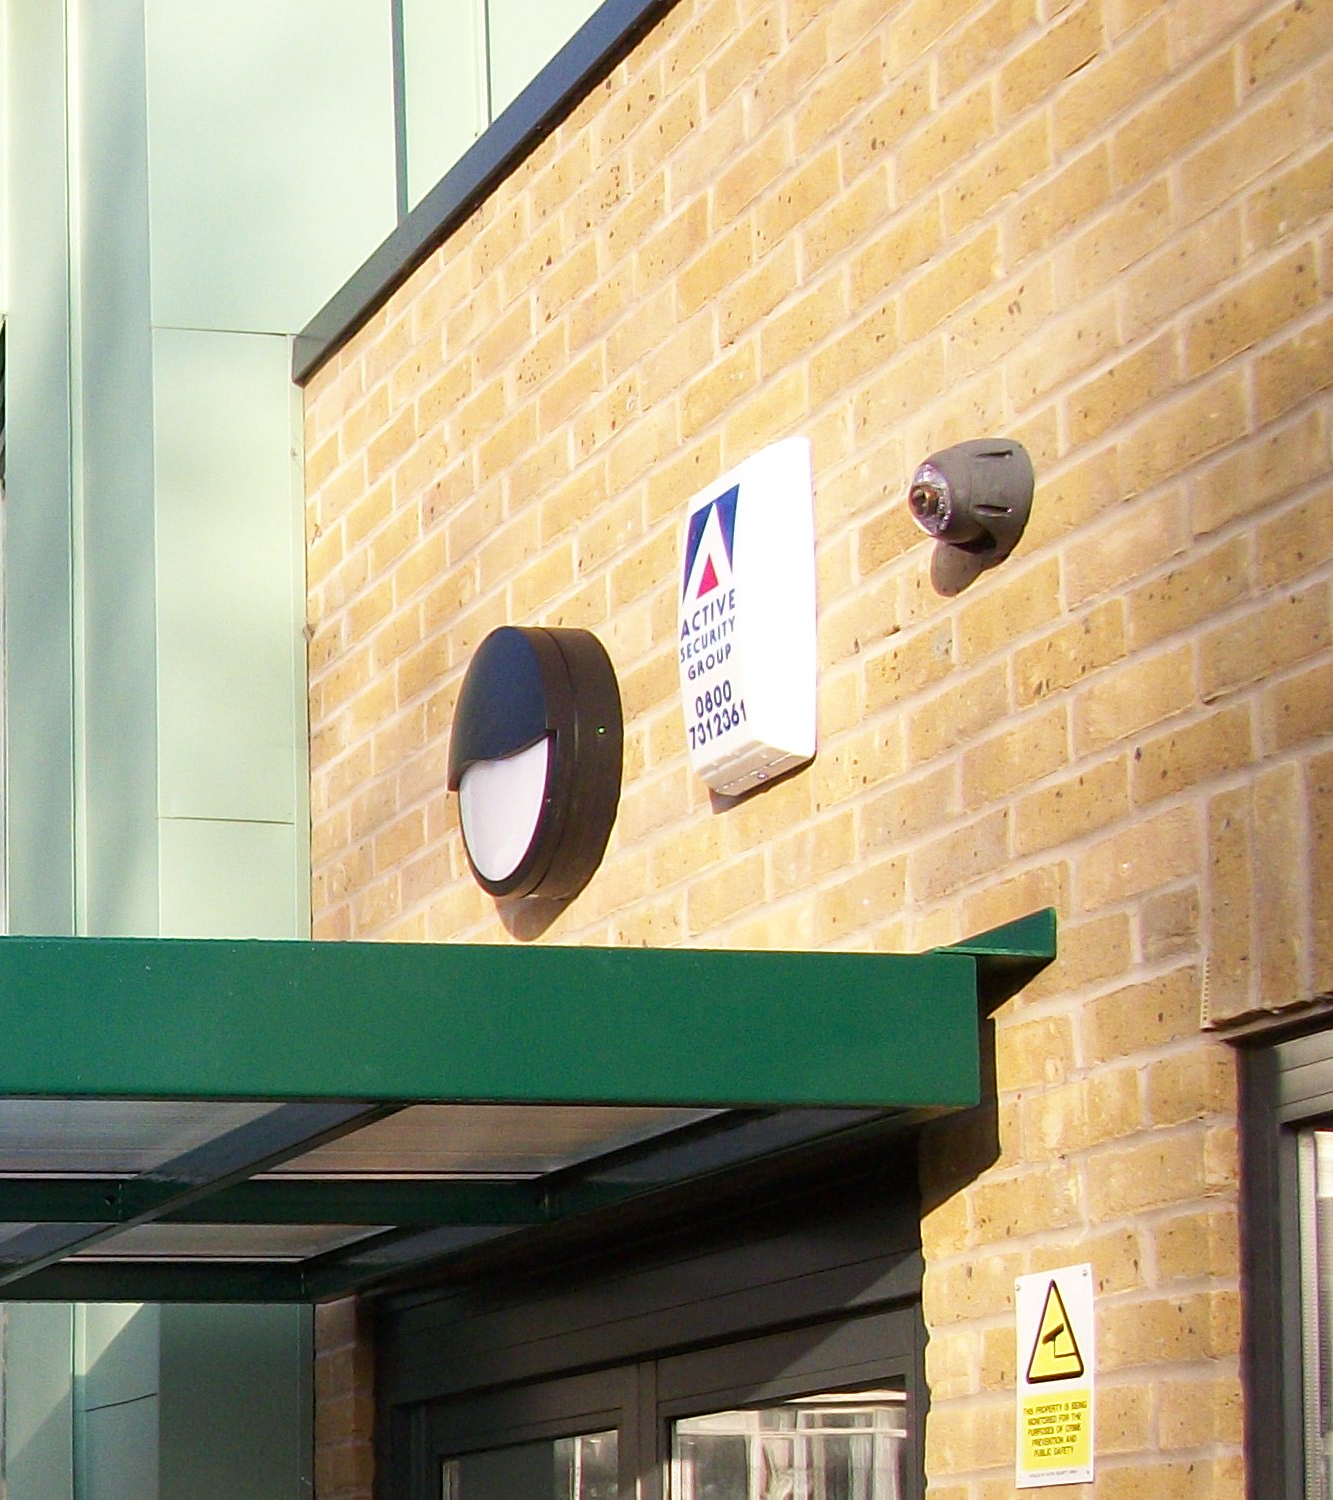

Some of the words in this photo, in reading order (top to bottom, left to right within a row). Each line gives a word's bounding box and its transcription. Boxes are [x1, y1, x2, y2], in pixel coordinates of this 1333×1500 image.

[681, 588, 736, 641] ACTIVE
[680, 616, 735, 663] SECURITY
[688, 643, 731, 680] GROUP
[695, 680, 732, 718] 0800
[689, 699, 747, 750] 7312361
[1035, 1404, 1062, 1414] PROPERTY
[1071, 1412, 1081, 1420] THE
[1056, 1425, 1063, 1433] OF
[1034, 1448, 1051, 1457] PUBLIC
[1053, 1446, 1073, 1455] SAFETY
